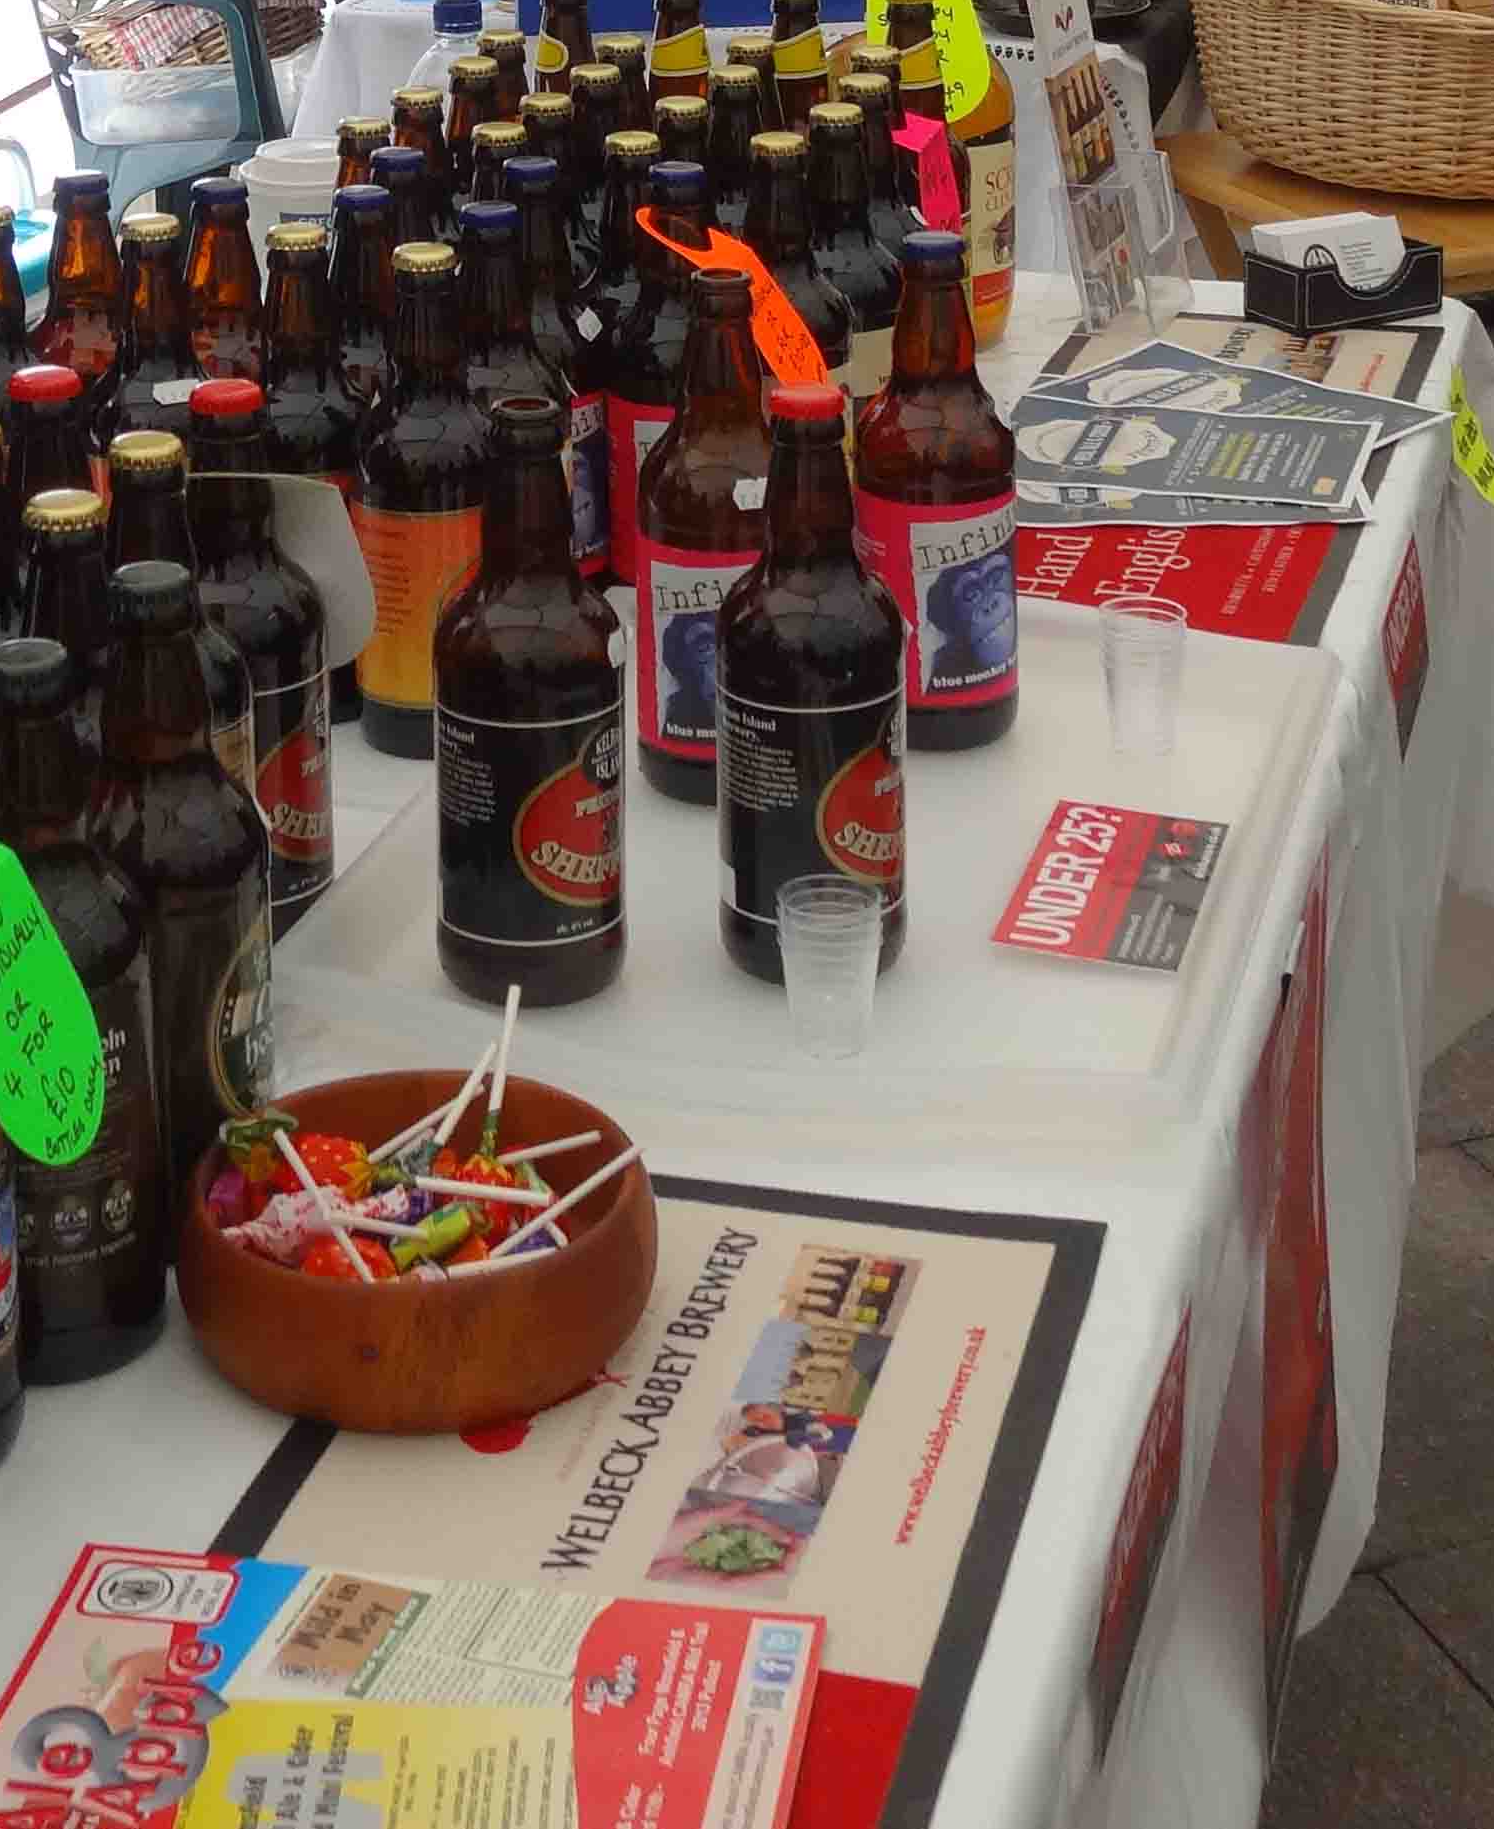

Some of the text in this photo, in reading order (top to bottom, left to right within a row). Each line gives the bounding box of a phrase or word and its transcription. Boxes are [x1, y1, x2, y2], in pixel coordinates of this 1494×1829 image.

[655, 578, 724, 613] Infi
[1016, 531, 1094, 600] Hand
[1092, 525, 1192, 612] Englis
[1008, 805, 1124, 948] UNDER 25?
[6, 989, 31, 1032] OR
[4, 1009, 54, 1100] 4 FOR
[541, 1438, 659, 1574] WELBECK
[623, 1328, 699, 1438] ABBEY
[679, 1225, 760, 1341] BREWERY
